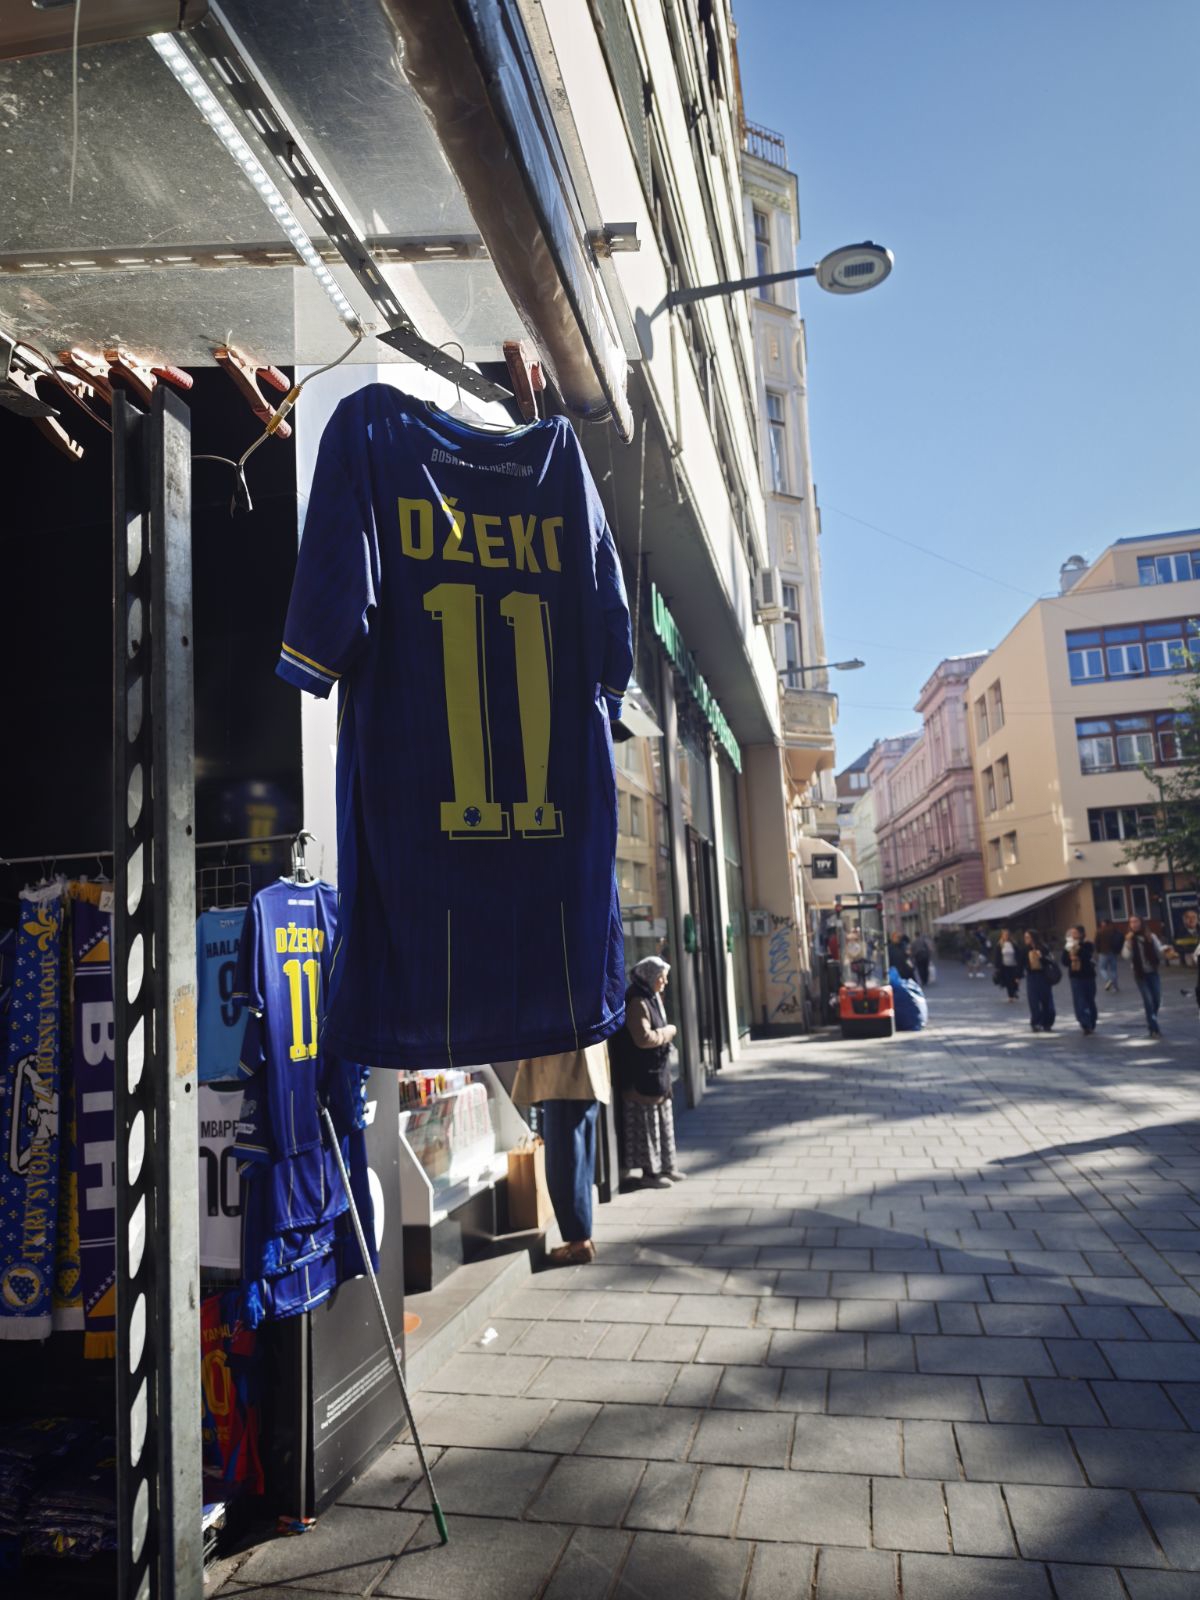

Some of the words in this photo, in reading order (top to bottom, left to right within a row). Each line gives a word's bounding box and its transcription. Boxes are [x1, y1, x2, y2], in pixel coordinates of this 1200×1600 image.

[423, 582, 564, 840] 11
[205, 939, 240, 959] HAALA
[275, 921, 325, 953] DŽEKO
[219, 960, 241, 1027] 9
[283, 959, 321, 1062] 11
[200, 1120, 240, 1138] MBAPP
